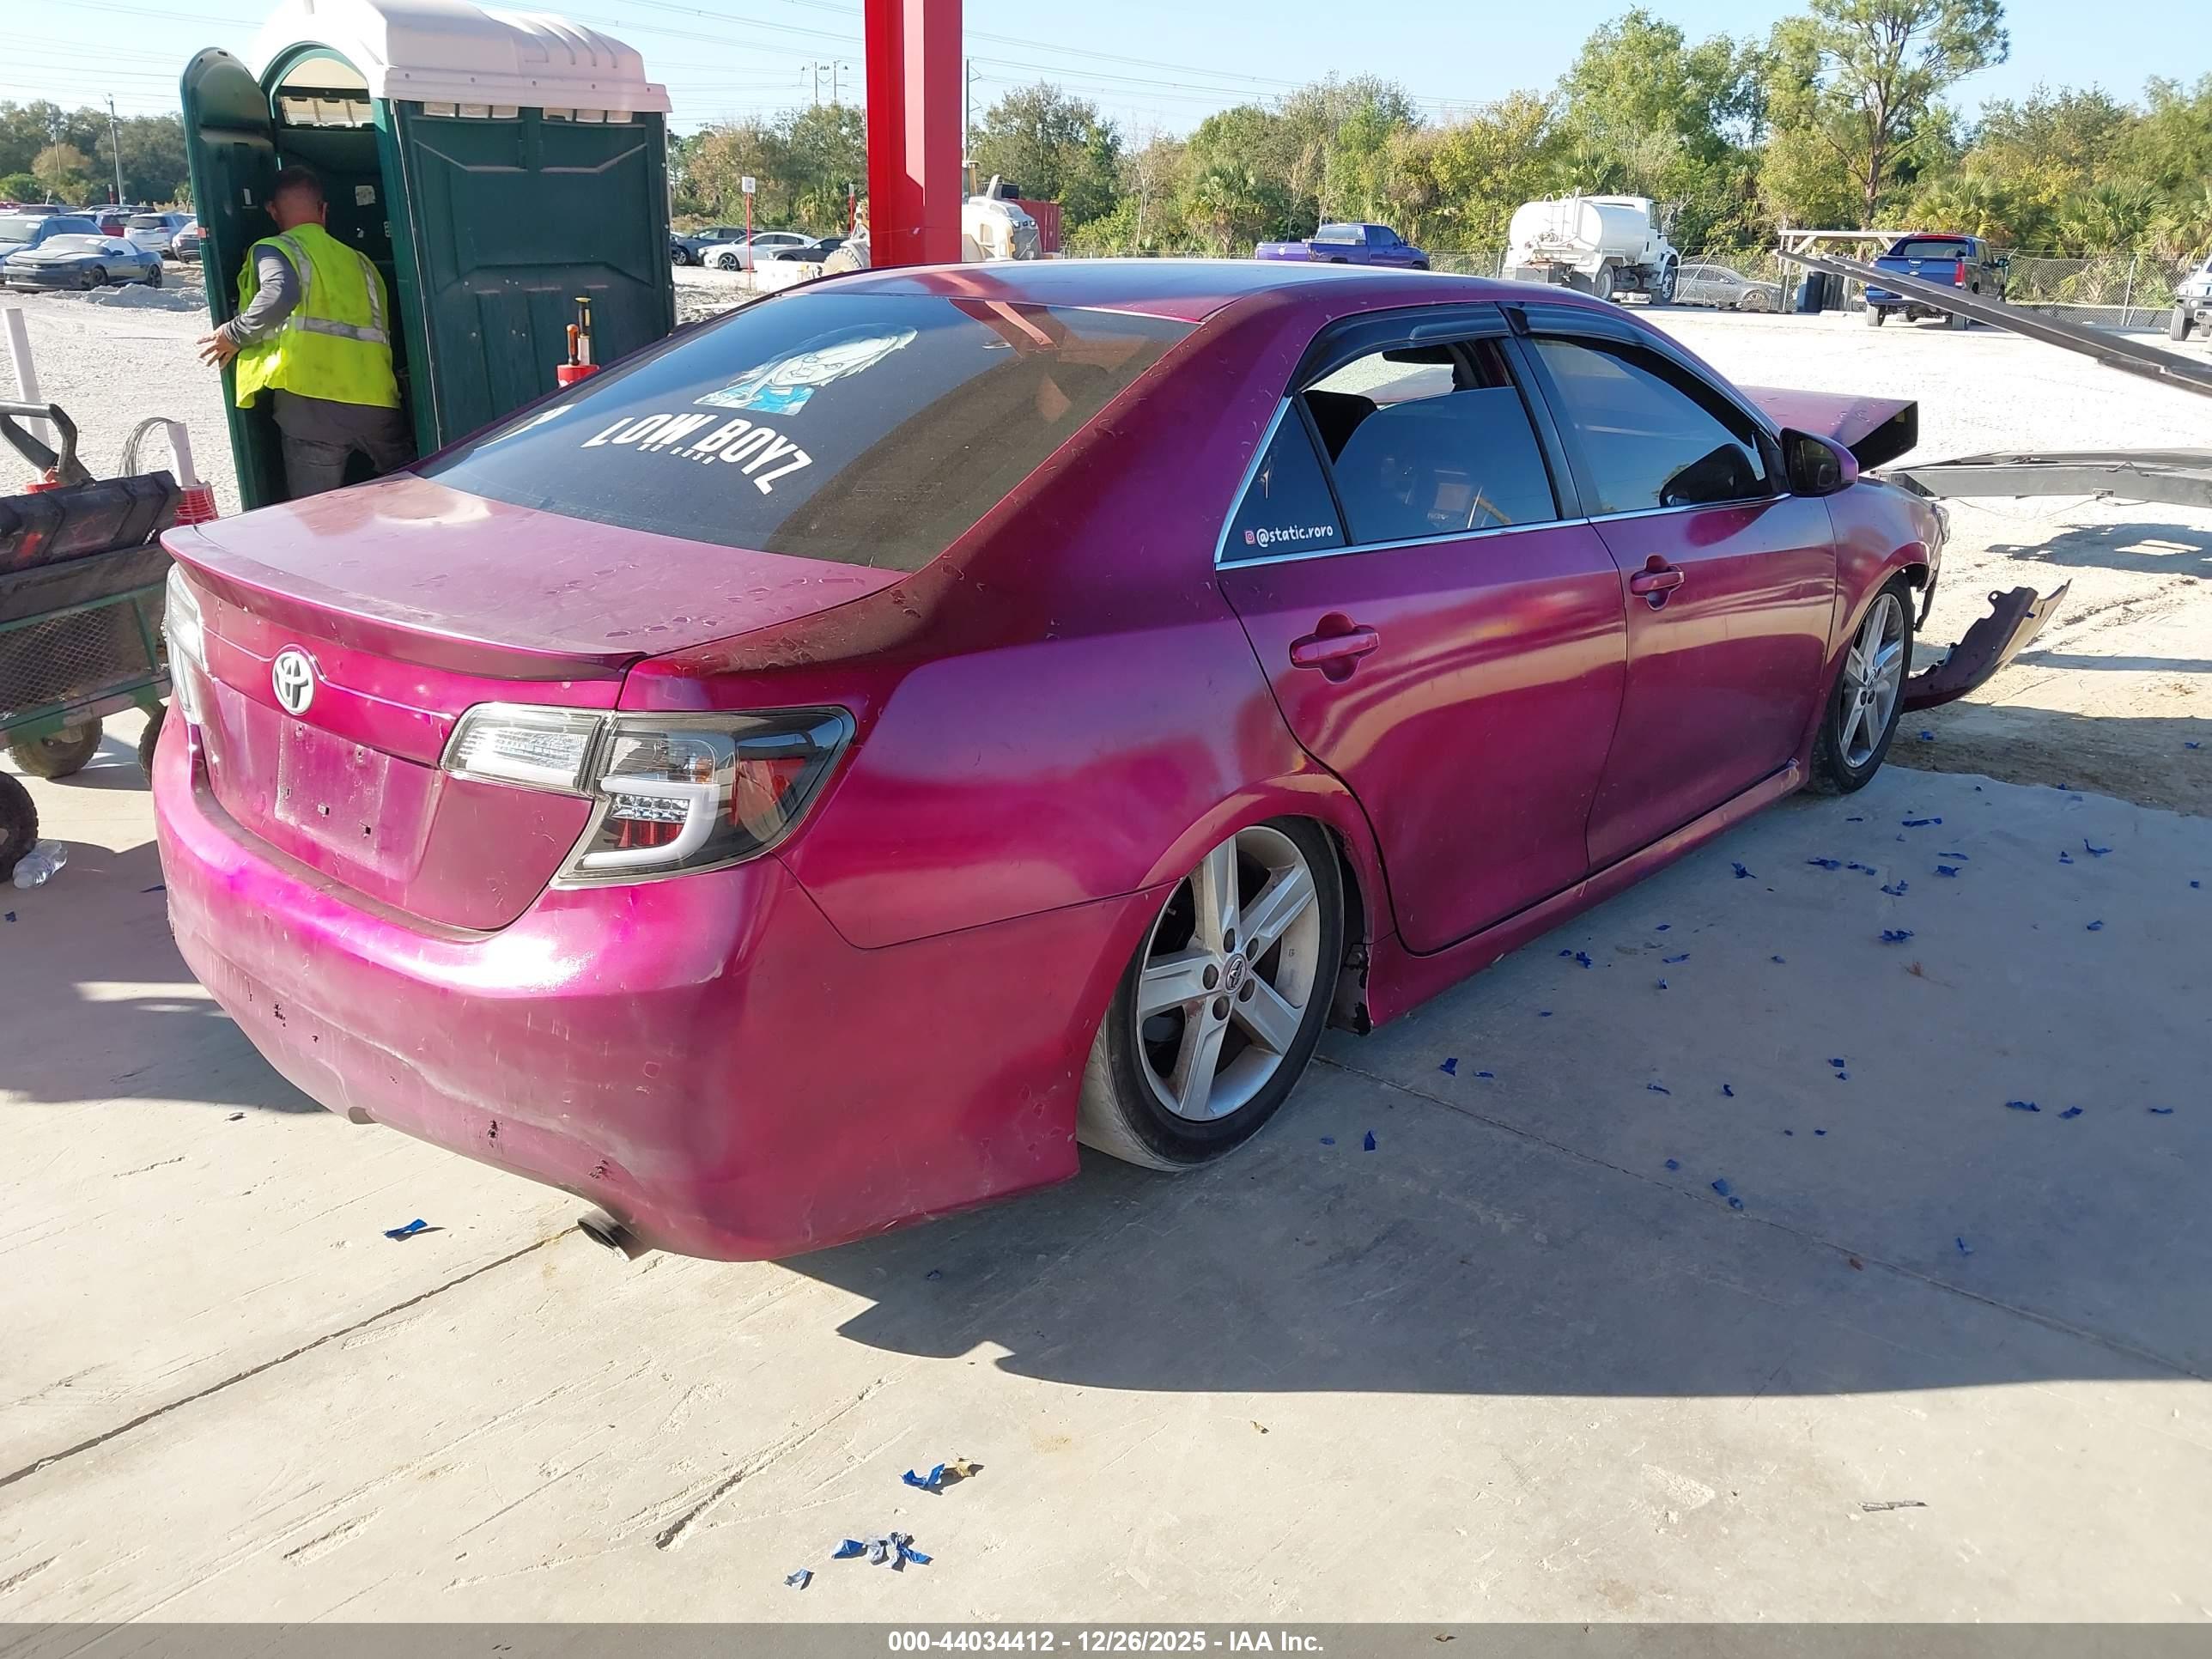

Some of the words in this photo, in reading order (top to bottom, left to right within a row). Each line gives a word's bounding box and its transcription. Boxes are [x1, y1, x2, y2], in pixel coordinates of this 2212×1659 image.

[580, 413, 719, 448] LOW
[691, 418, 813, 495] BOYZ
[1256, 525, 1334, 548] @static.roro
